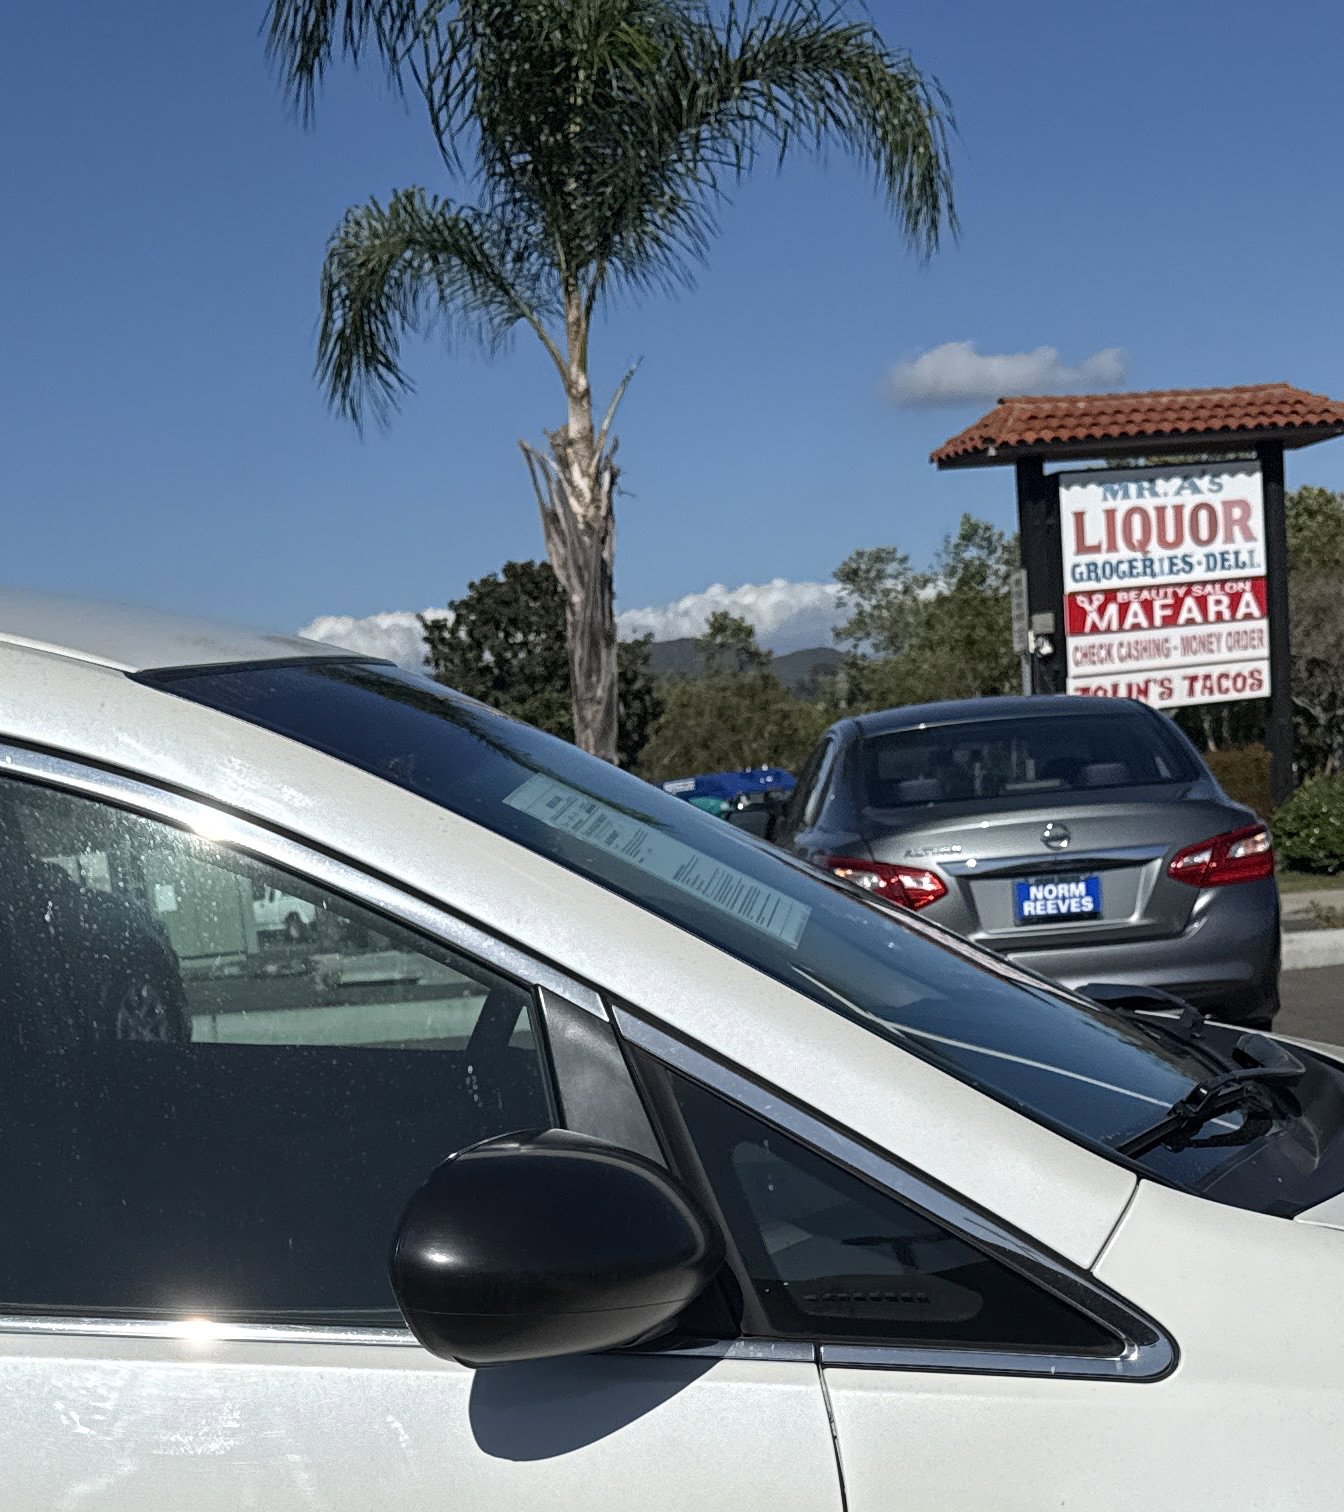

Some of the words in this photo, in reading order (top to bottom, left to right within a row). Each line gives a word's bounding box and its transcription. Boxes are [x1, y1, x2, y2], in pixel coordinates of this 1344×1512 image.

[1072, 499, 1258, 557] LIQUOR
[1070, 553, 1194, 584] GROCERIES
[1116, 585, 1189, 604] BEAUTY
[1190, 579, 1253, 598] SALON
[1082, 591, 1262, 634] MAFARA
[1071, 641, 1116, 668] CHECK
[1116, 635, 1172, 664] CASHING
[1179, 631, 1223, 658] MONEY
[1224, 627, 1265, 652] ORDER
[1183, 667, 1264, 699] TACOS
[1022, 895, 1095, 917] REEVES
[1029, 881, 1087, 900] NORM
